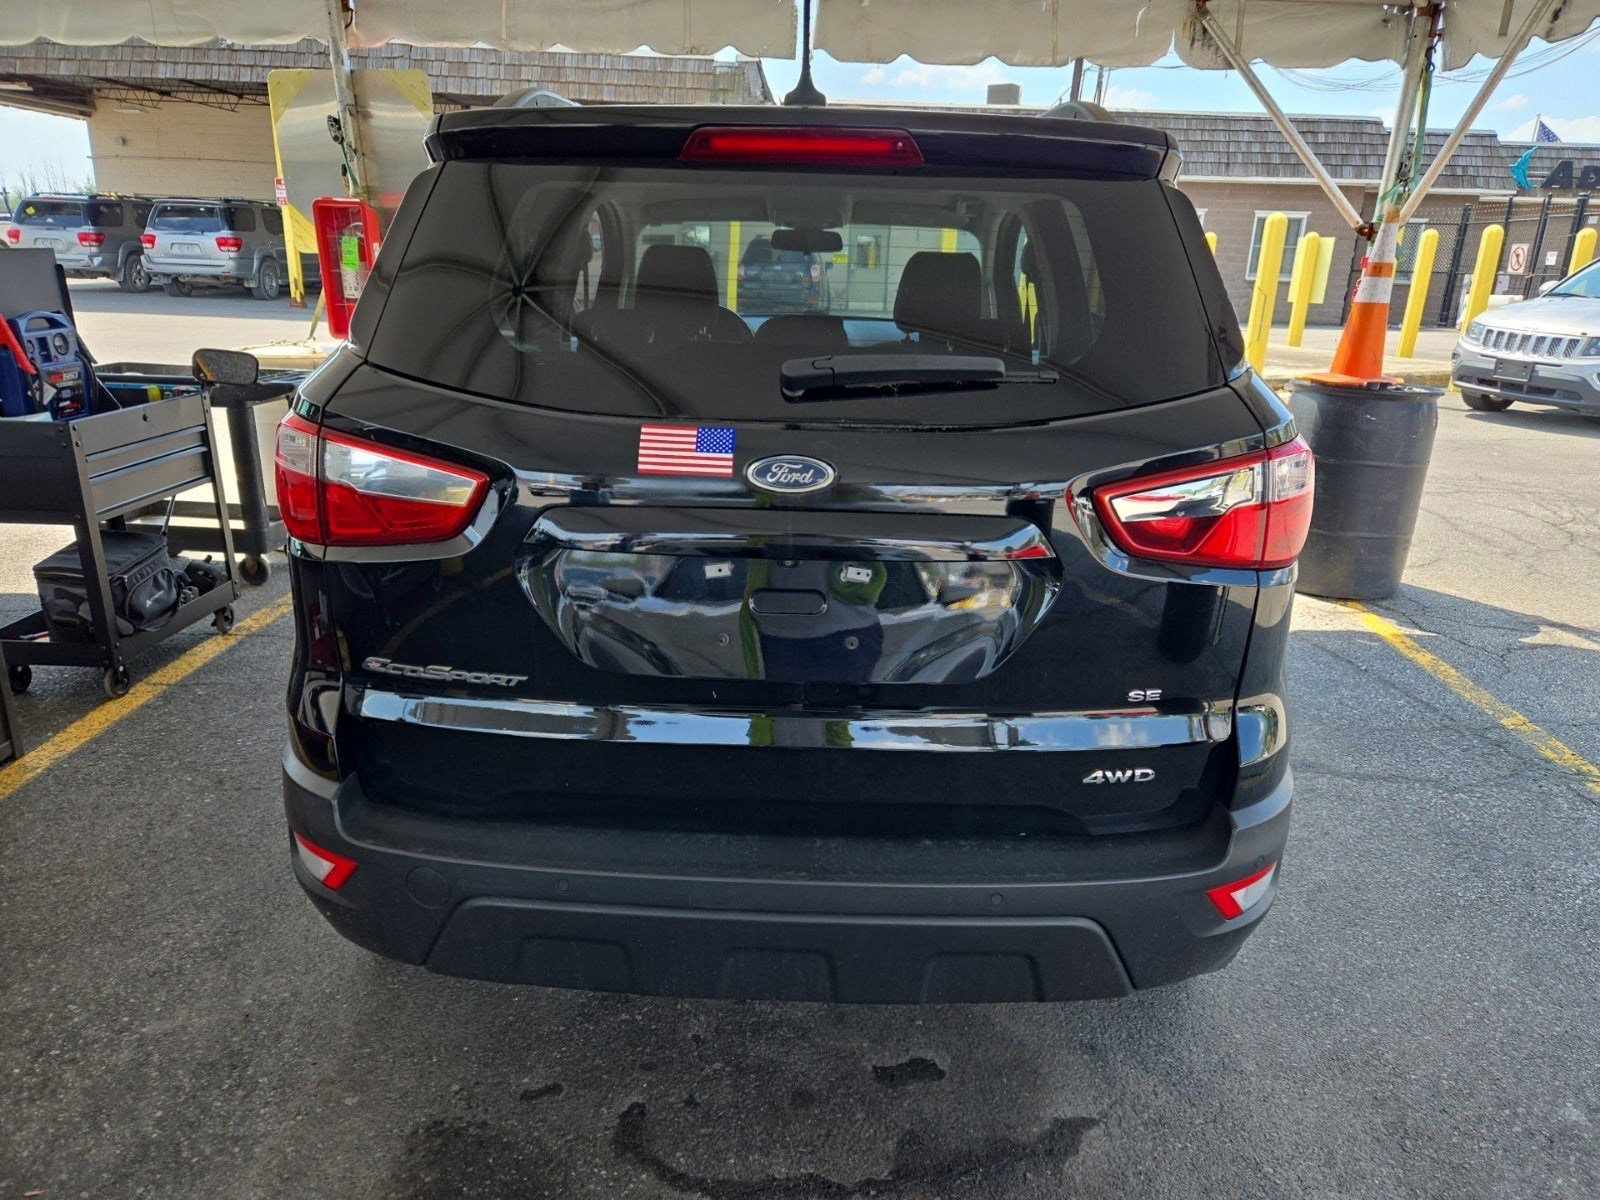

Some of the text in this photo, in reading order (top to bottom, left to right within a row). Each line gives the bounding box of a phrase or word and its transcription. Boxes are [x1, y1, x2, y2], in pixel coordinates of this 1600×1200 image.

[766, 462, 815, 484] Ford
[1127, 689, 1163, 702] SE
[1082, 768, 1156, 785] 4WD
